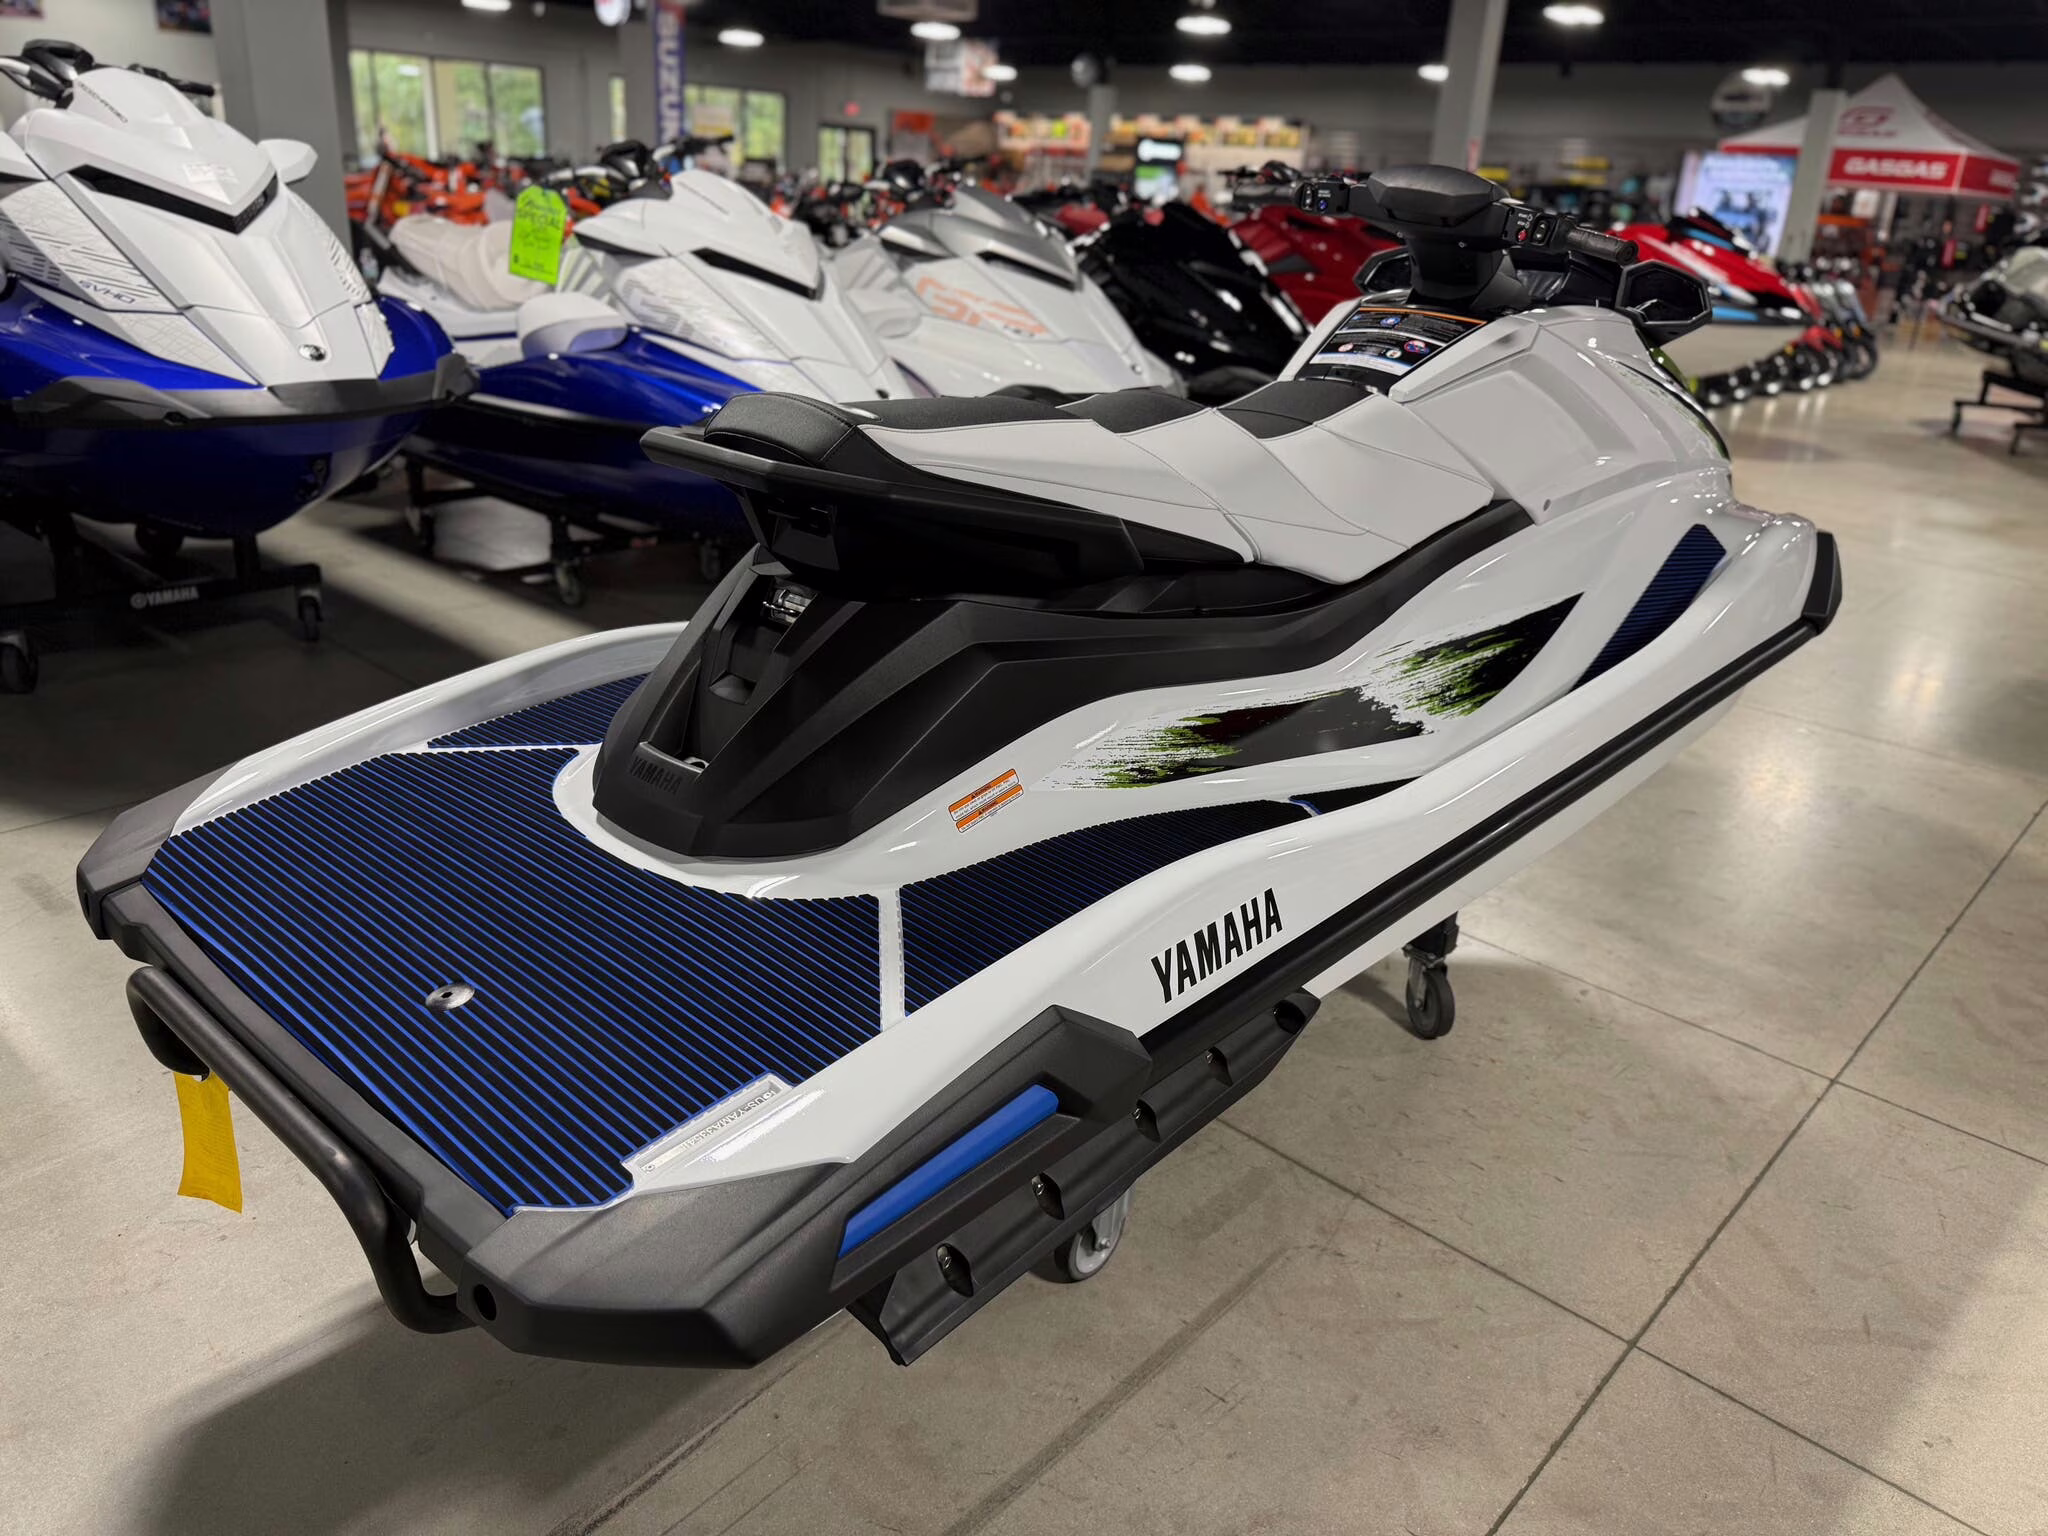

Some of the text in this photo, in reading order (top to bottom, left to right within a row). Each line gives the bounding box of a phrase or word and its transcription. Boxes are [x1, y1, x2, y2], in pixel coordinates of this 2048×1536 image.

[656, 11, 682, 146] SUZUK
[1843, 156, 1949, 180] GASGAS
[147, 586, 199, 607] YAMAHA
[630, 755, 683, 795] YAMAHA
[1150, 888, 1283, 1004] YAMAHA
